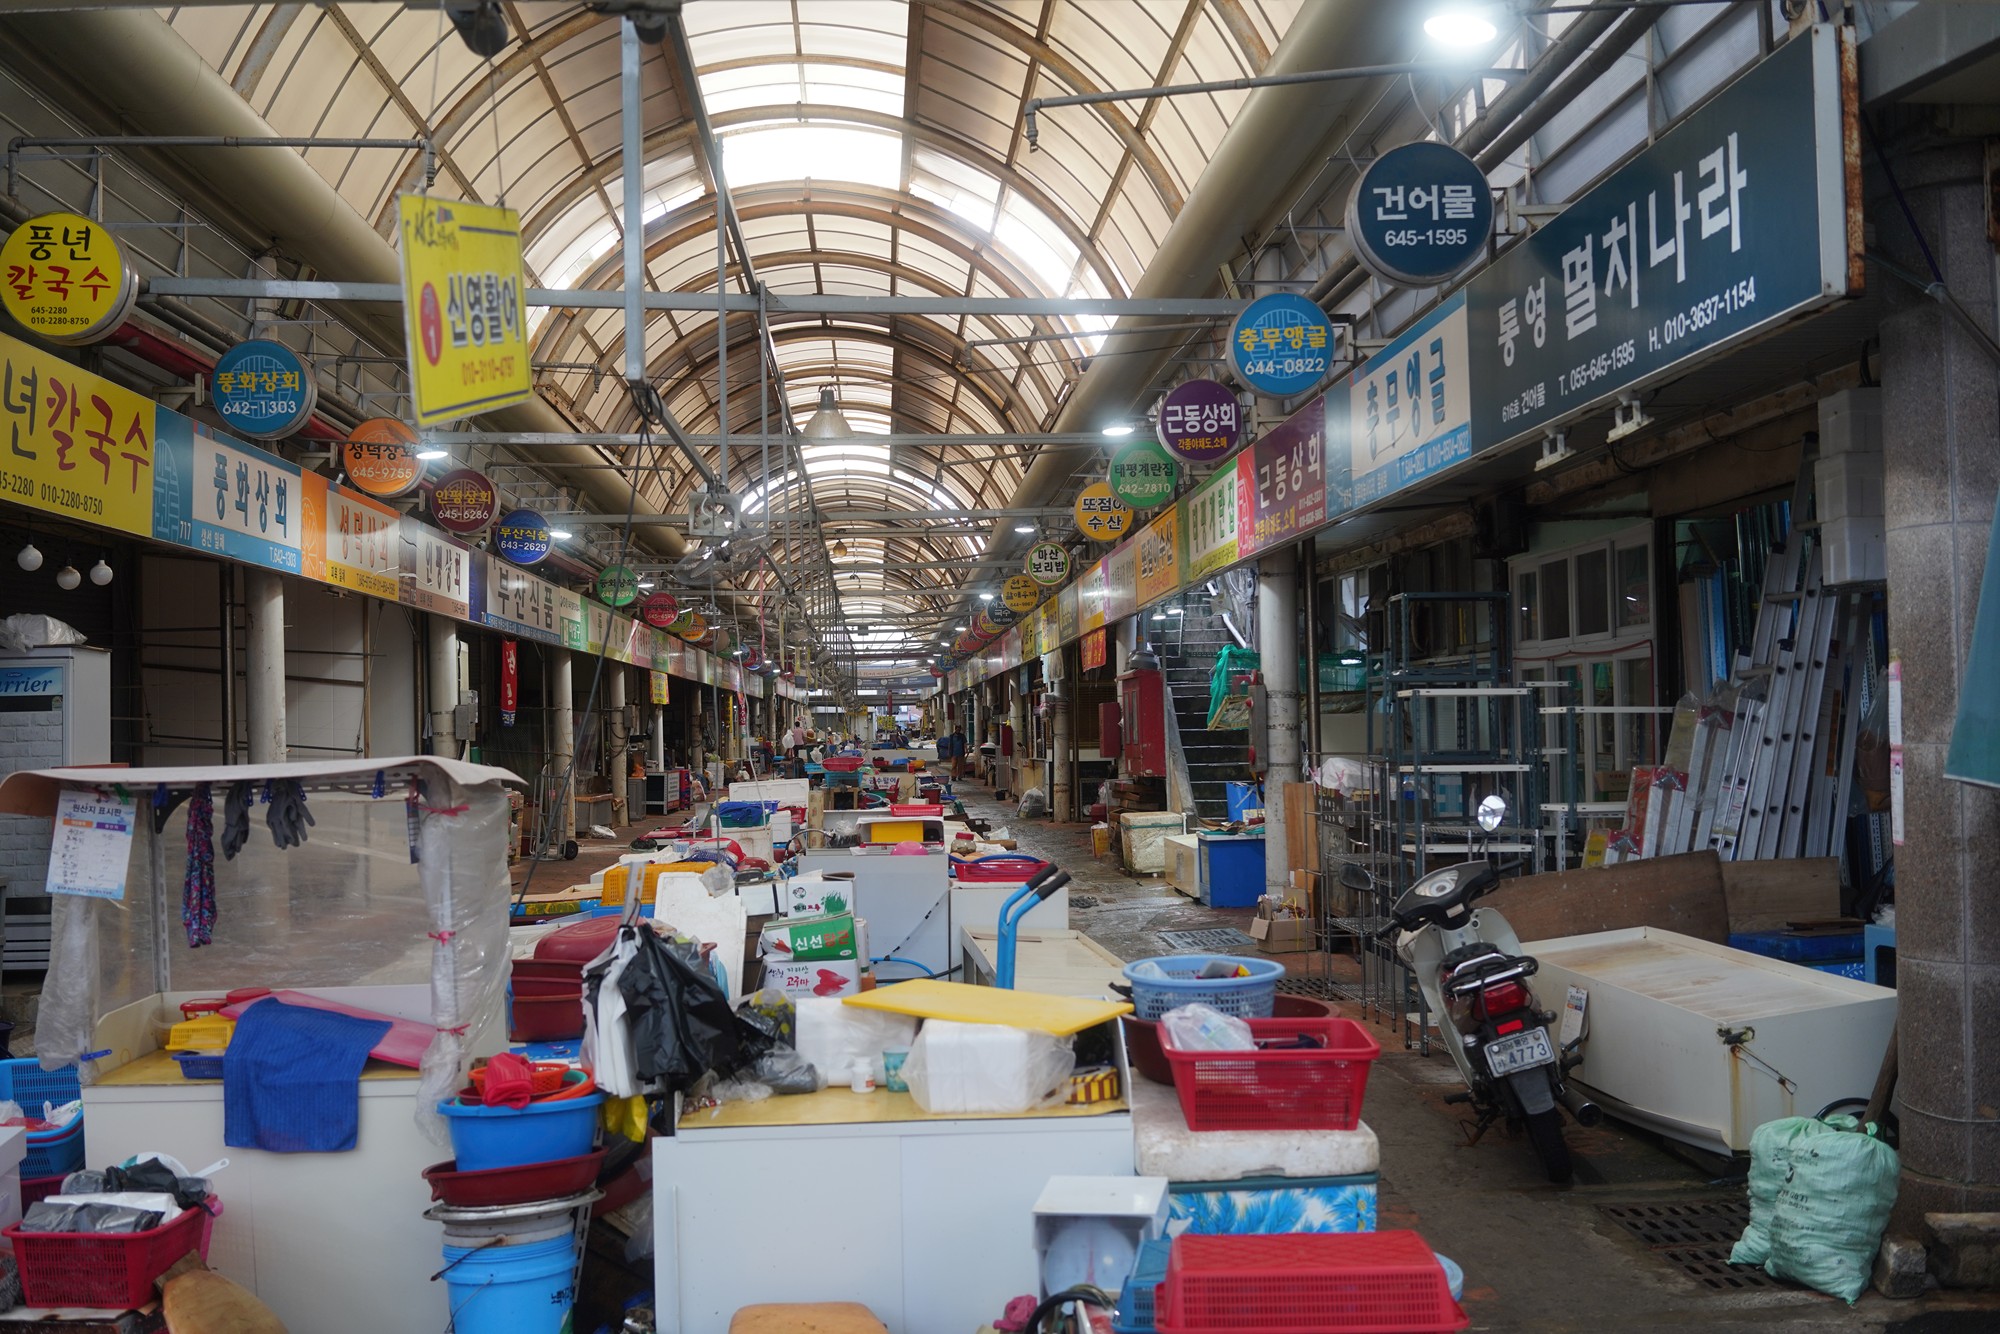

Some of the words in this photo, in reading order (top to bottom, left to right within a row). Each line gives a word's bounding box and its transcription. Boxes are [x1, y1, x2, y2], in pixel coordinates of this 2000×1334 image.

[1372, 184, 1476, 221] 건어물
[26, 225, 92, 261] 풍년
[1384, 229, 1467, 246] 645-1595
[1497, 276, 1547, 367] 통영
[1561, 131, 1748, 342] 멸치나라
[7, 265, 112, 302] 칼국수
[30, 306, 68, 316] 645-2280
[447, 272, 521, 347] 신영활어
[30, 316, 90, 326] 010-2280-8750
[1237, 325, 1327, 352] 충무앵글
[1502, 398, 1520, 423] 616호
[1521, 382, 1546, 415] 건어물
[1558, 374, 1568, 396] T.
[1569, 339, 1636, 390] 055-645-1595
[1648, 326, 1661, 353] H.
[1664, 275, 1756, 345] 010-3637-1154
[1244, 357, 1325, 376] 644-0822
[216, 371, 300, 393] 풍화상회
[222, 400, 298, 416] 642-1303
[1366, 336, 1446, 462] 충무앵글
[1166, 403, 1236, 433] 근동상회
[351, 467, 413, 480] 645-9755
[1114, 462, 1174, 479] 태평계란집
[1260, 431, 1321, 509] 근동상회
[213, 452, 287, 539] 풍화상회
[435, 490, 491, 505] 안평상회
[1117, 483, 1171, 494] 642-7810
[41, 483, 103, 515] 010-2280-8750
[438, 509, 489, 520] 645-6286
[1087, 515, 1123, 531] 수산
[179, 520, 192, 541] 717
[500, 541, 547, 552] 643-2629
[1038, 549, 1059, 560] 마산
[1032, 561, 1065, 573] 보리밥
[498, 566, 553, 629] 부산식품
[72, 803, 96, 815] 원산지
[98, 806, 122, 817] 표시판
[786, 976, 809, 988] 고구마
[1509, 1043, 1547, 1064] 4773
